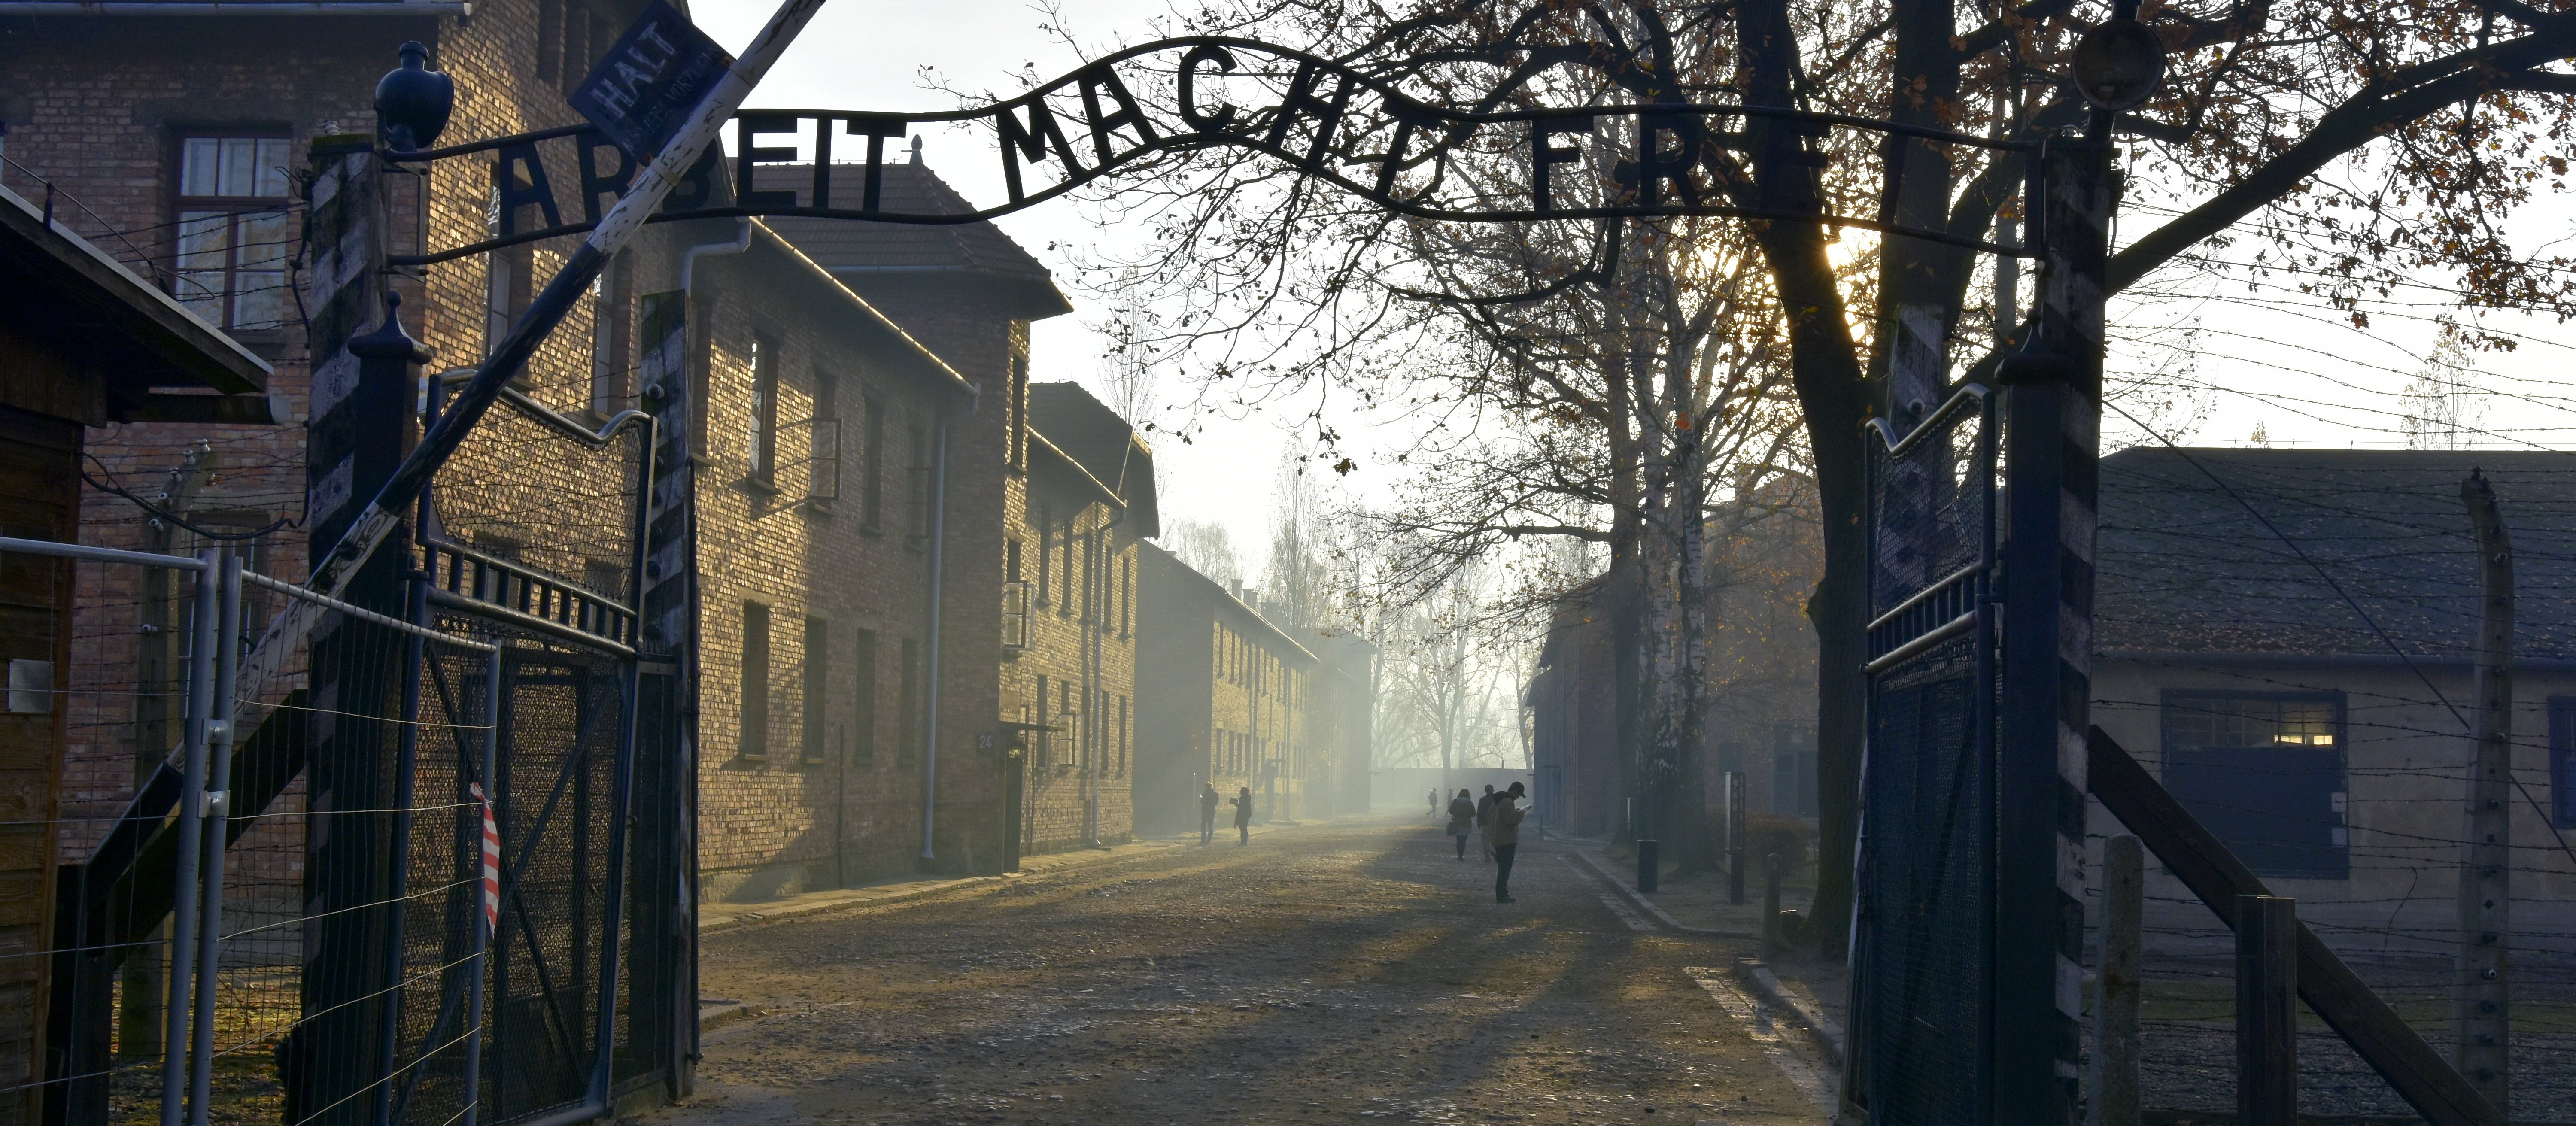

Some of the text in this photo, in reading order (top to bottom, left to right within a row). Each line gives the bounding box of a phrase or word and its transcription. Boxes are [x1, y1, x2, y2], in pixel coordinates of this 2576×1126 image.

[498, 44, 1908, 237] ARBEIT MACHT FREI
[591, 21, 675, 118] HALT
